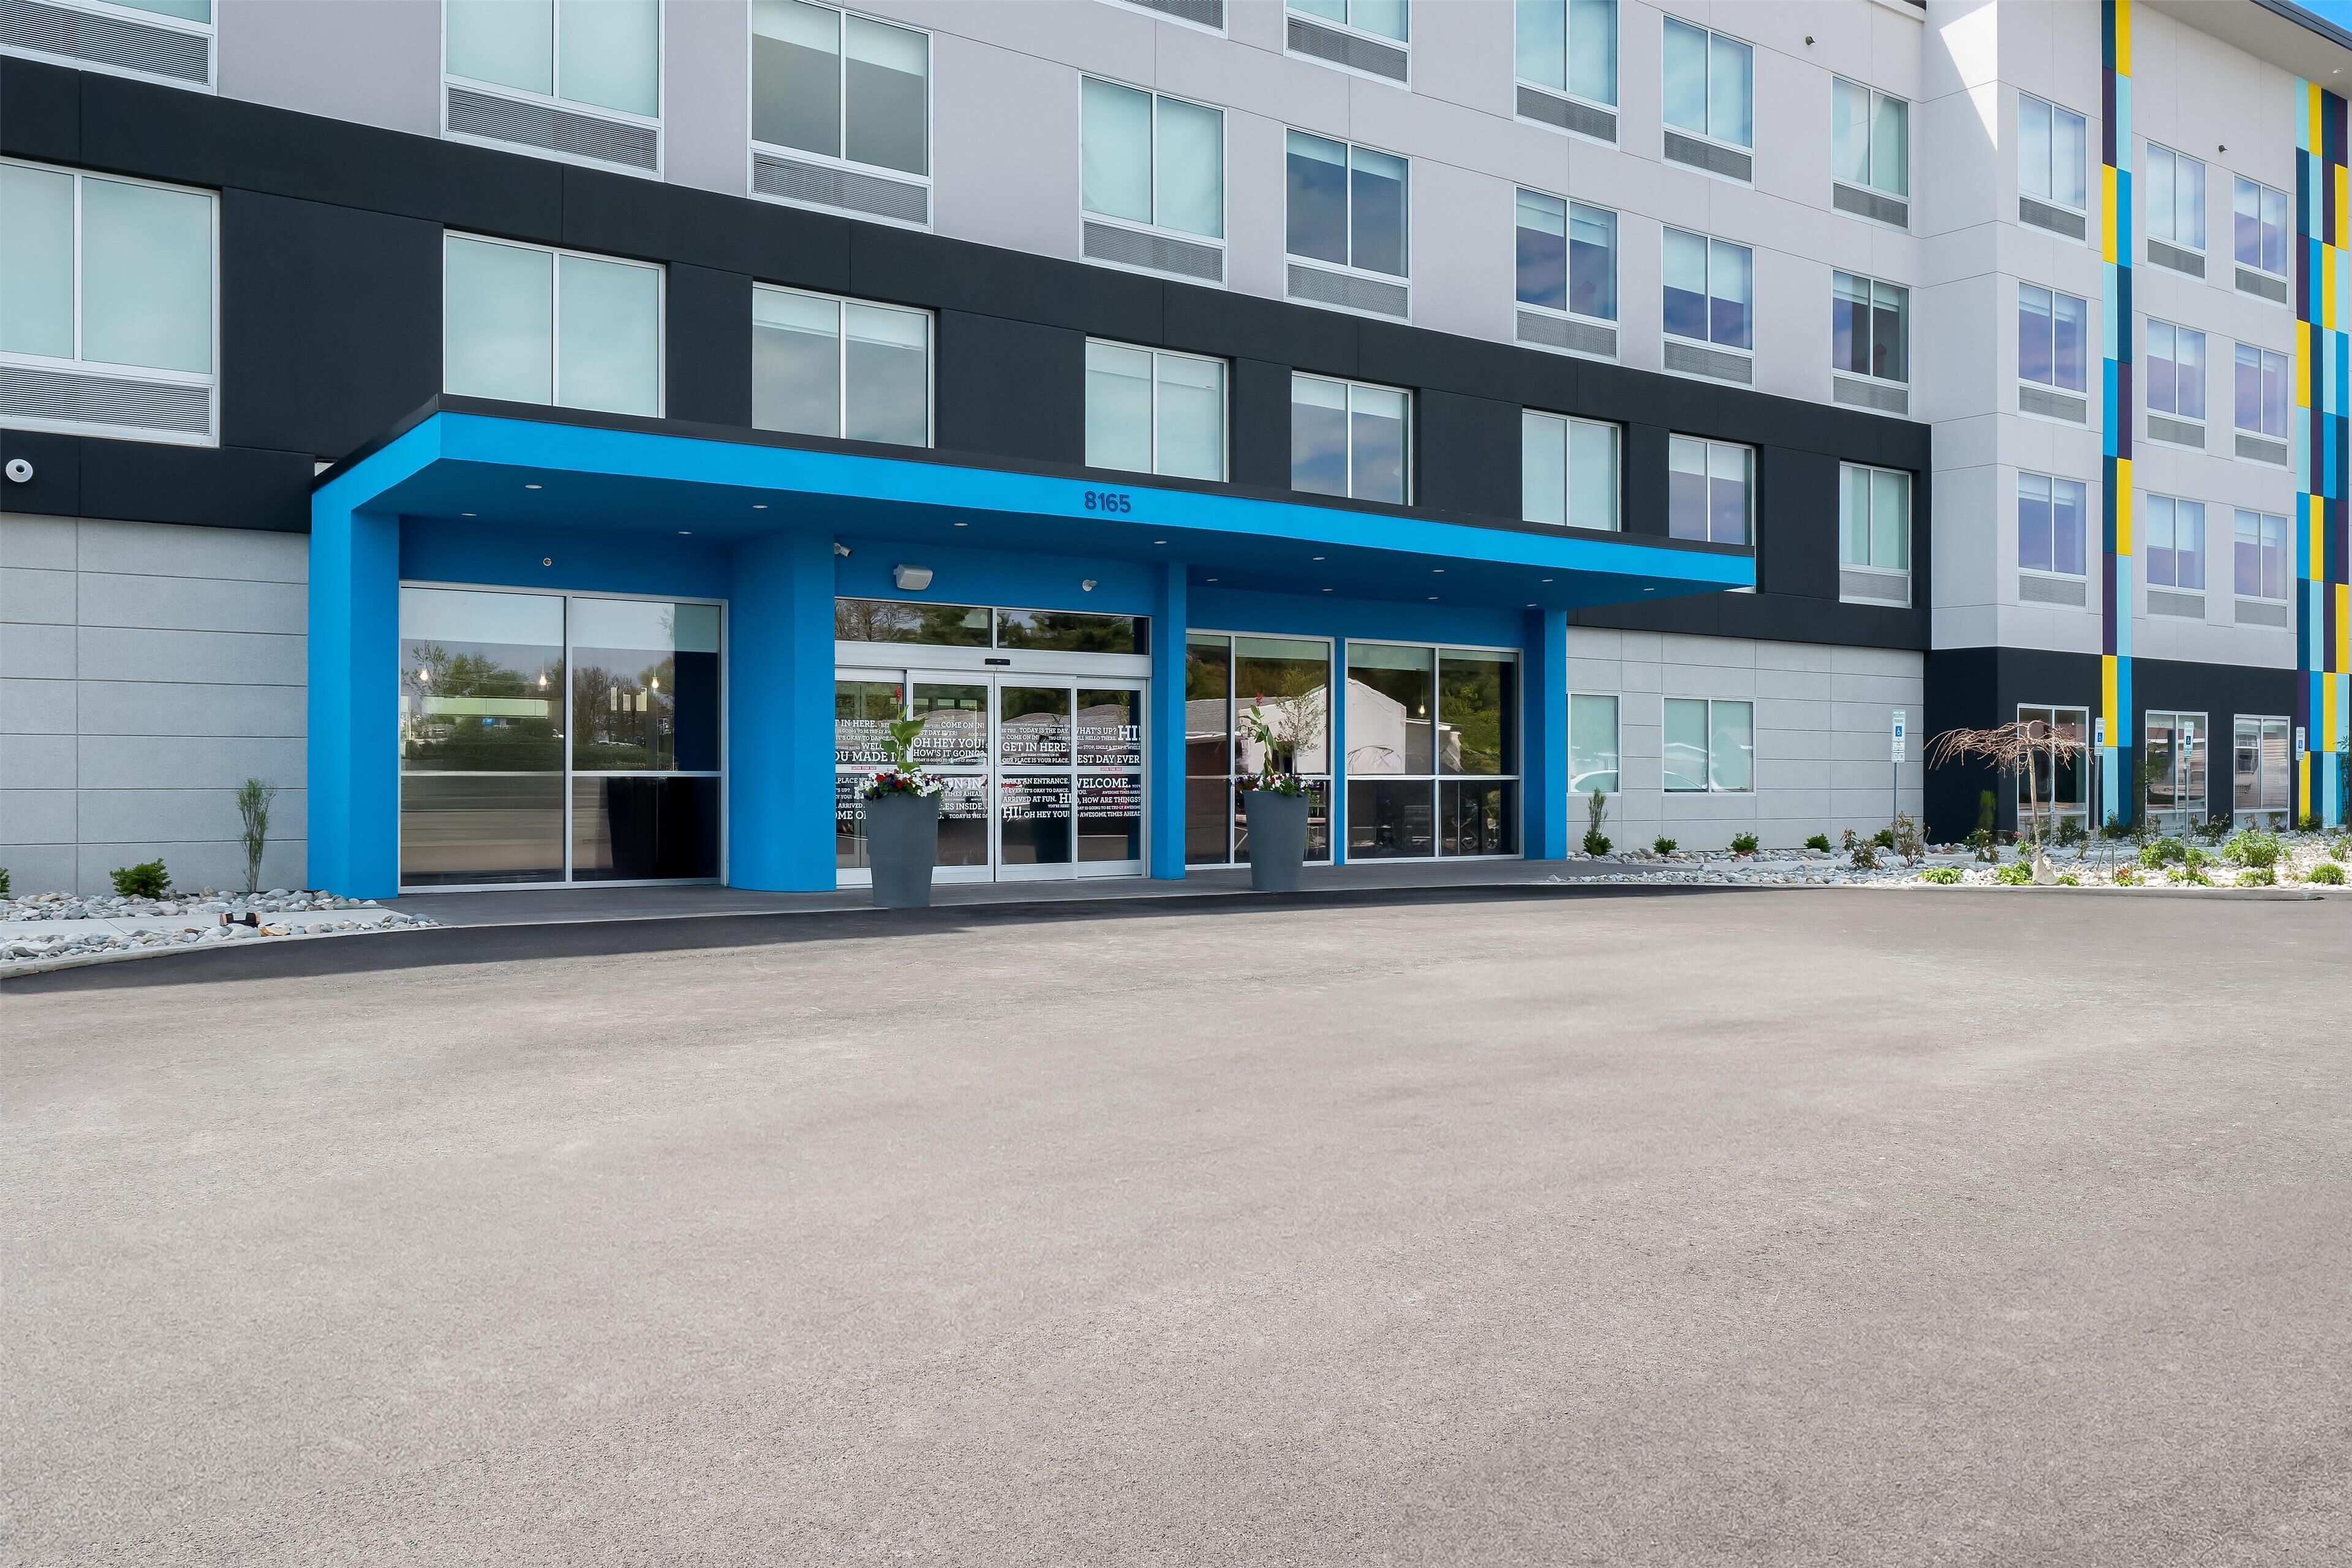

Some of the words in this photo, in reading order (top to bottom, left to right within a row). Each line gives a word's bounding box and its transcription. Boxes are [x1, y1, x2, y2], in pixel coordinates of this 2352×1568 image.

[1084, 491, 1131, 513] 8165
[913, 738, 930, 747] OH
[933, 738, 956, 748] HEY
[958, 739, 984, 748] YOU!
[1002, 742, 1023, 752] GET
[1025, 742, 1038, 752] IN
[1039, 742, 1069, 752] HERE.
[835, 751, 849, 761] OU
[851, 751, 888, 762] MADE
[1077, 755, 1094, 763] EST
[1096, 755, 1115, 763] DAY
[1117, 755, 1140, 763] EVER
[835, 811, 853, 820] ME
[1002, 806, 1022, 818] HI!
